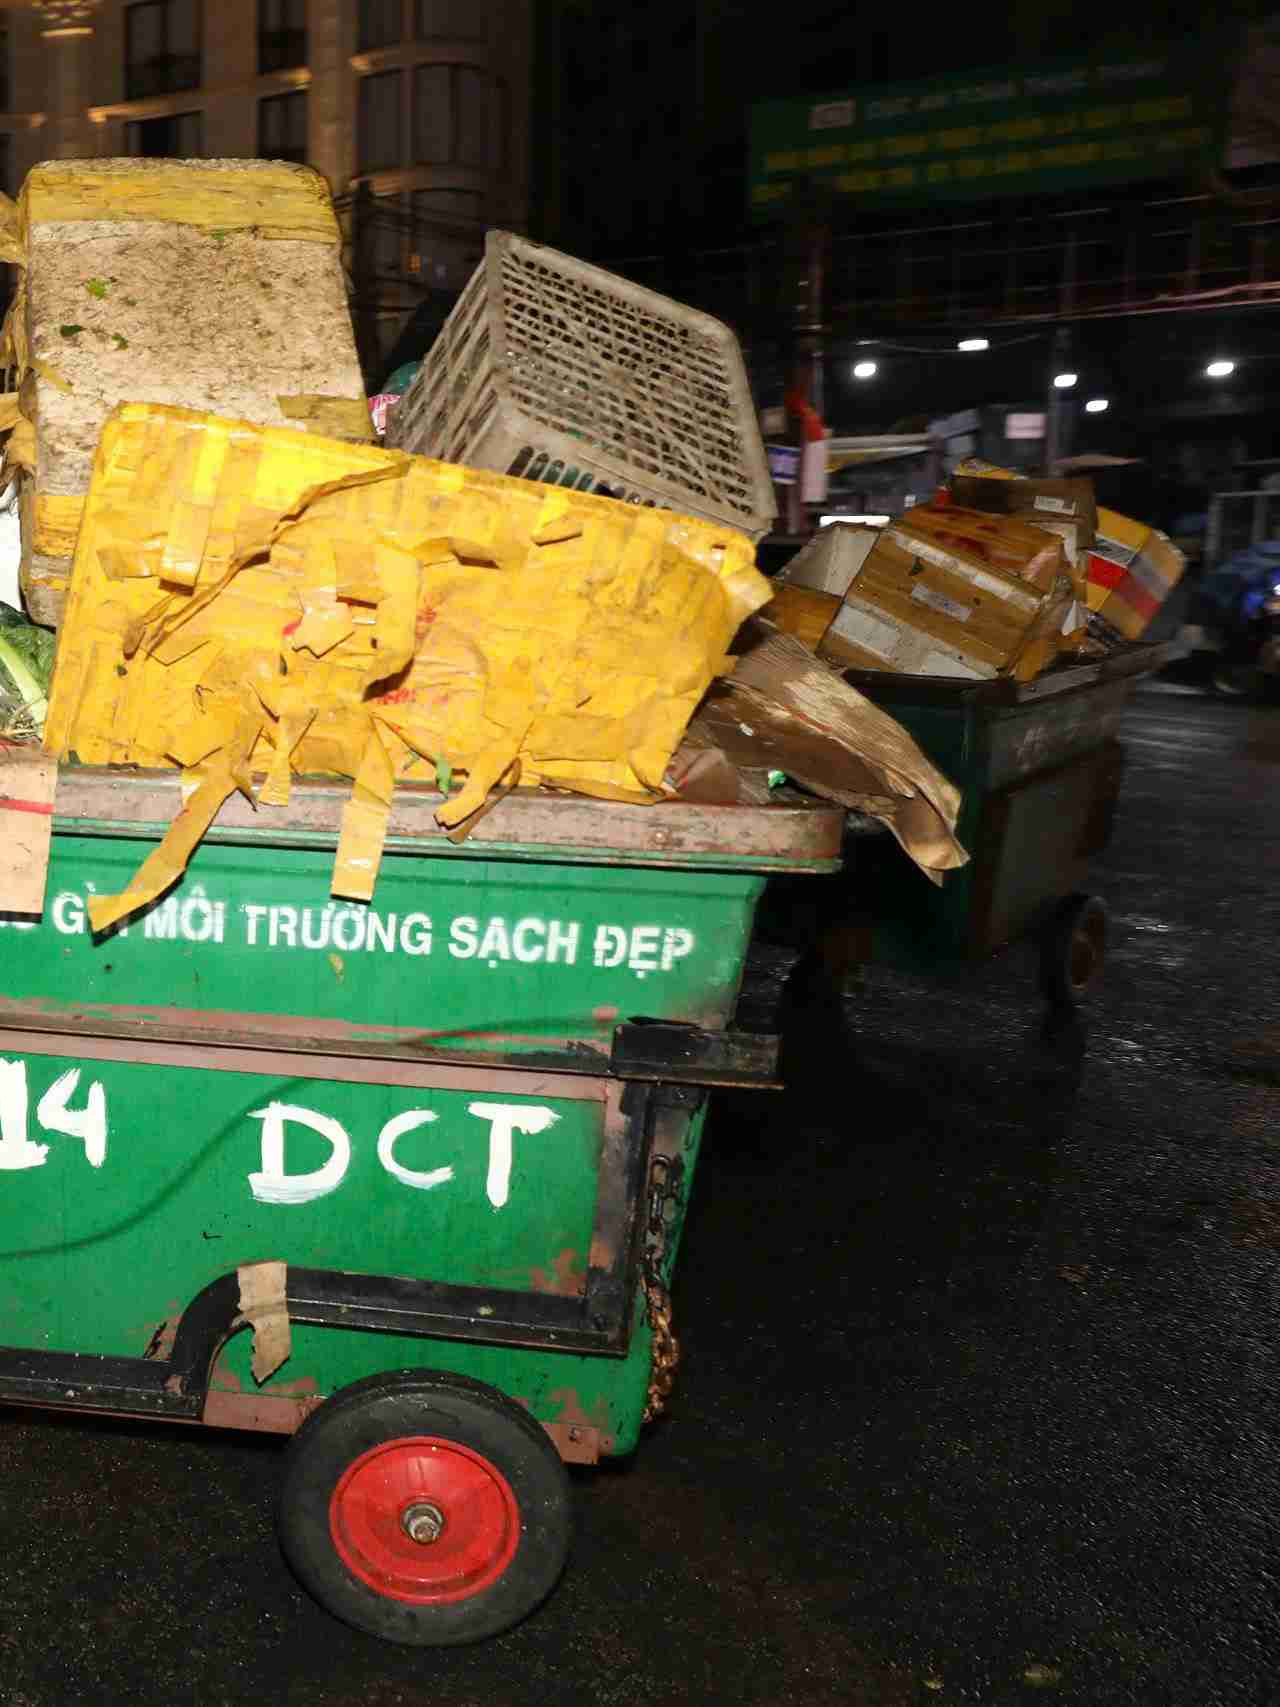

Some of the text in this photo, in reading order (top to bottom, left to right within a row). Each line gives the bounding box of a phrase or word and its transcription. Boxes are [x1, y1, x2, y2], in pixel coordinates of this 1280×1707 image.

[144, 885, 225, 943] MÔI
[448, 916, 580, 968] SẠCH
[593, 924, 695, 979] ĐẸP
